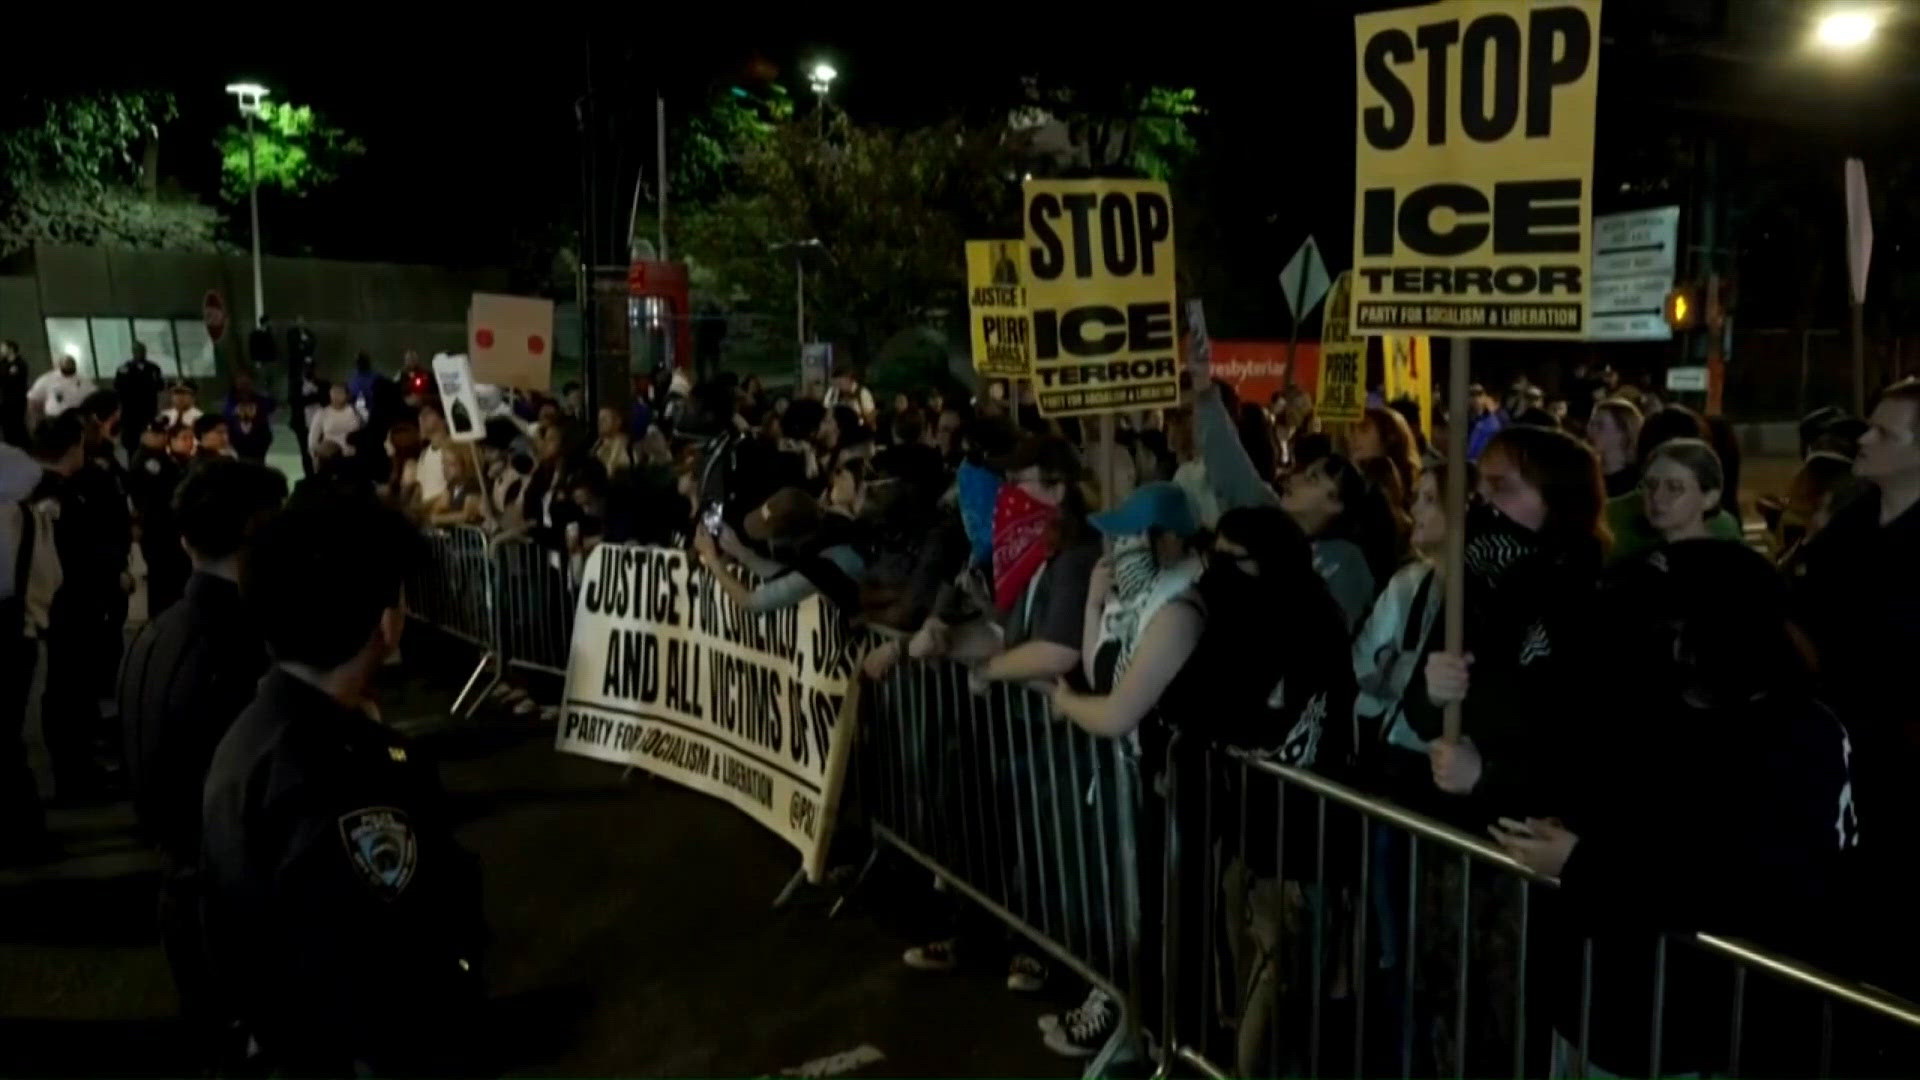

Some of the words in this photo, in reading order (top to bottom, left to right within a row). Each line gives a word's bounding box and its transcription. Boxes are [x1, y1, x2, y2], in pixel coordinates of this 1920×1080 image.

[1363, 6, 1591, 151] STOP
[1029, 191, 1169, 281] STOP
[1362, 178, 1582, 258] ICE
[972, 287, 1016, 307] JUSTICE
[1359, 265, 1582, 295] TERROR
[1361, 305, 1397, 325] PARTY
[1401, 305, 1422, 325] FOR
[1425, 304, 1485, 326] SOCIALISM
[1488, 306, 1498, 326] &
[1502, 304, 1577, 327] LIBERATION
[1033, 302, 1173, 361] ICE
[1036, 358, 1176, 387] TERROR
[586, 546, 681, 626] JUSTICE
[603, 629, 659, 701] AND
[665, 638, 703, 717] ALL
[709, 647, 782, 752] VICTIMS
[565, 712, 614, 745] PARTY
[614, 722, 641, 752] FOR
[640, 729, 711, 777] SOCIALISM
[712, 752, 720, 780] &
[722, 753, 774, 810] LIBERATION
